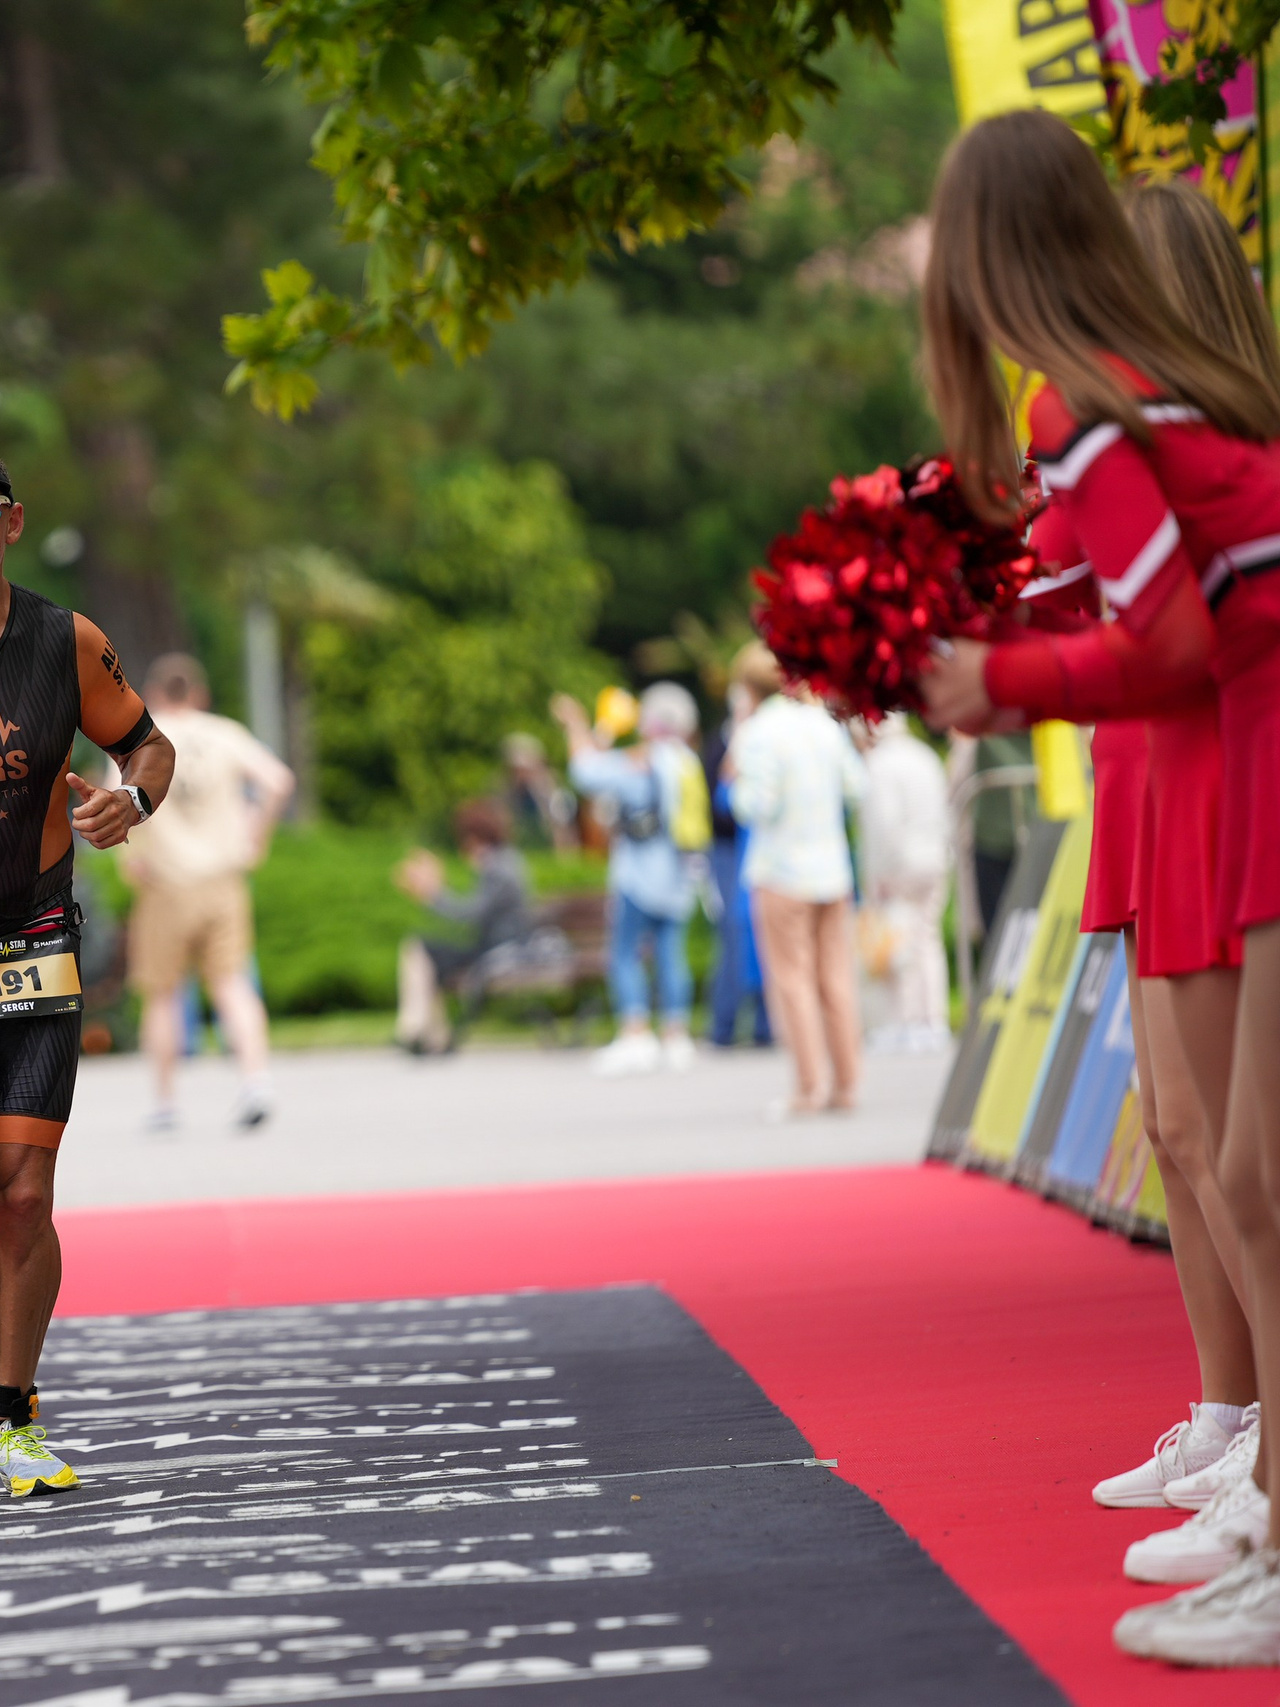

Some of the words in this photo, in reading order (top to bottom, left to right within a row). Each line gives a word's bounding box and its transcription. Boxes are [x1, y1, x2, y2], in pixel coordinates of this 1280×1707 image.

[10, 939, 26, 950] STAR
[1, 1001, 35, 1013] SERGEY
[256, 1416, 578, 1437] STAR
[239, 1458, 590, 1491] STAR
[230, 1483, 600, 1517] STAR
[231, 1551, 654, 1592] STAR
